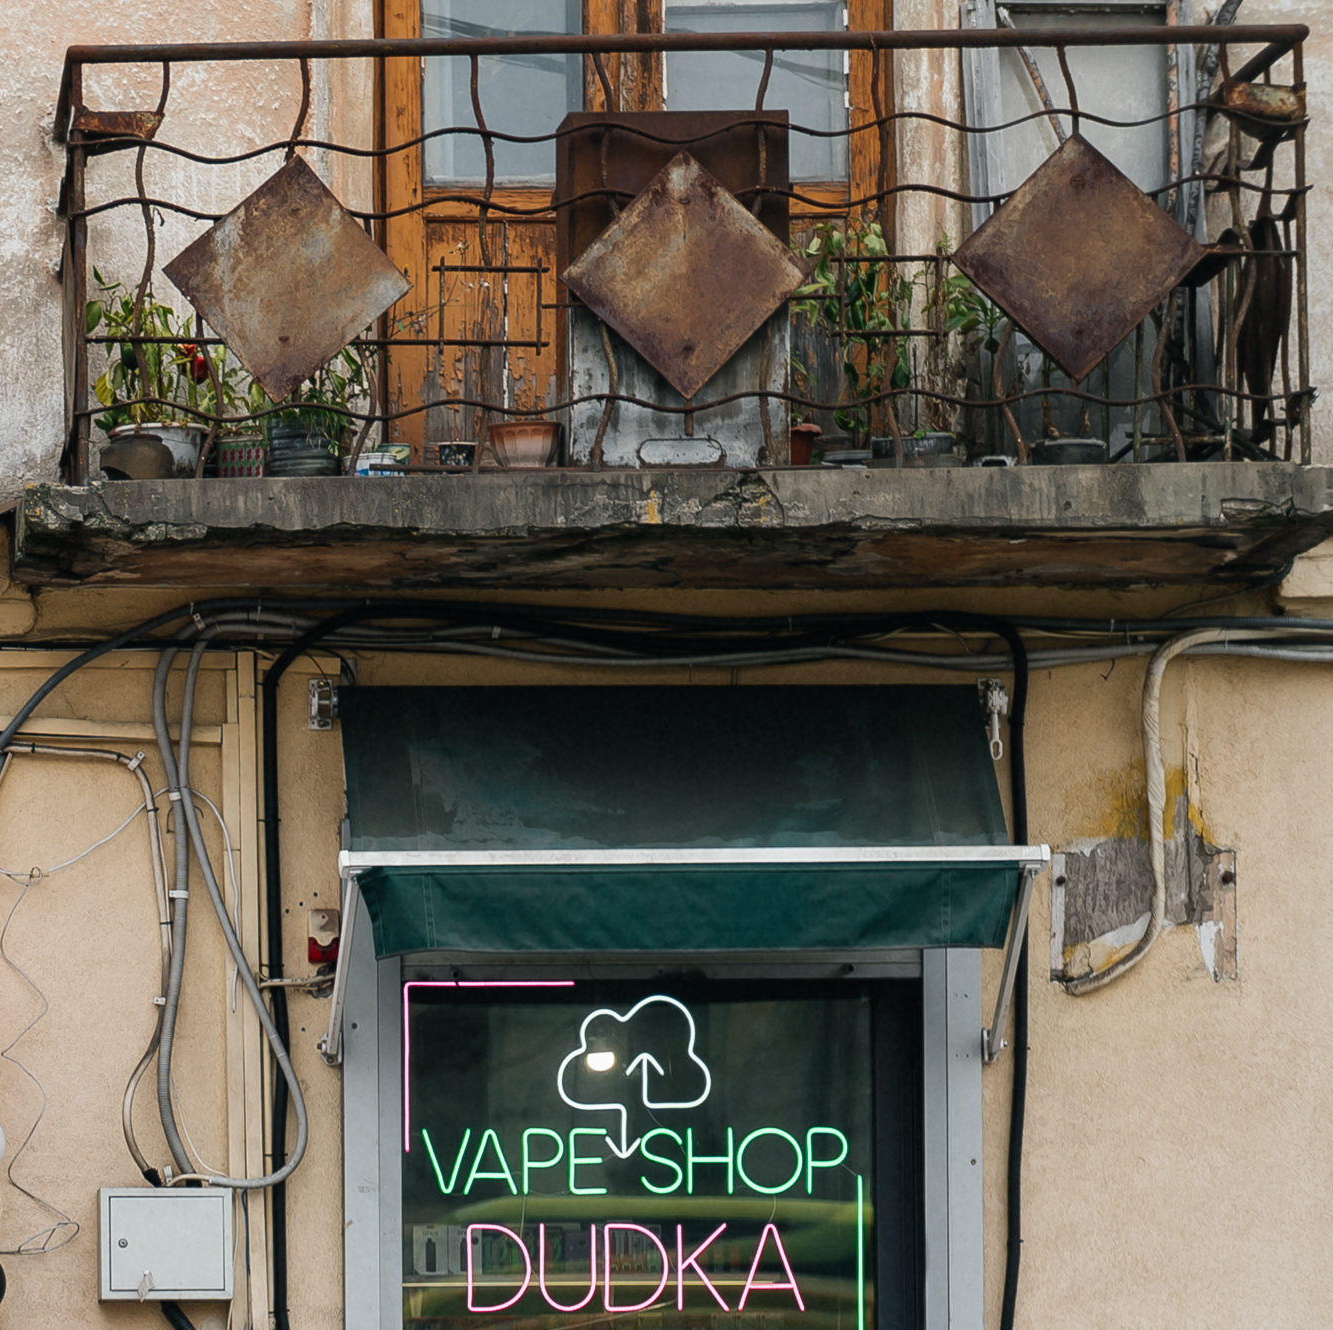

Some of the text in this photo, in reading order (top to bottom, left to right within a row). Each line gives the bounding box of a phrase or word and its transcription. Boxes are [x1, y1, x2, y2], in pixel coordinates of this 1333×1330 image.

[422, 1126, 848, 1195] VAPE SHOP
[466, 1223, 805, 1313] DUDKA
